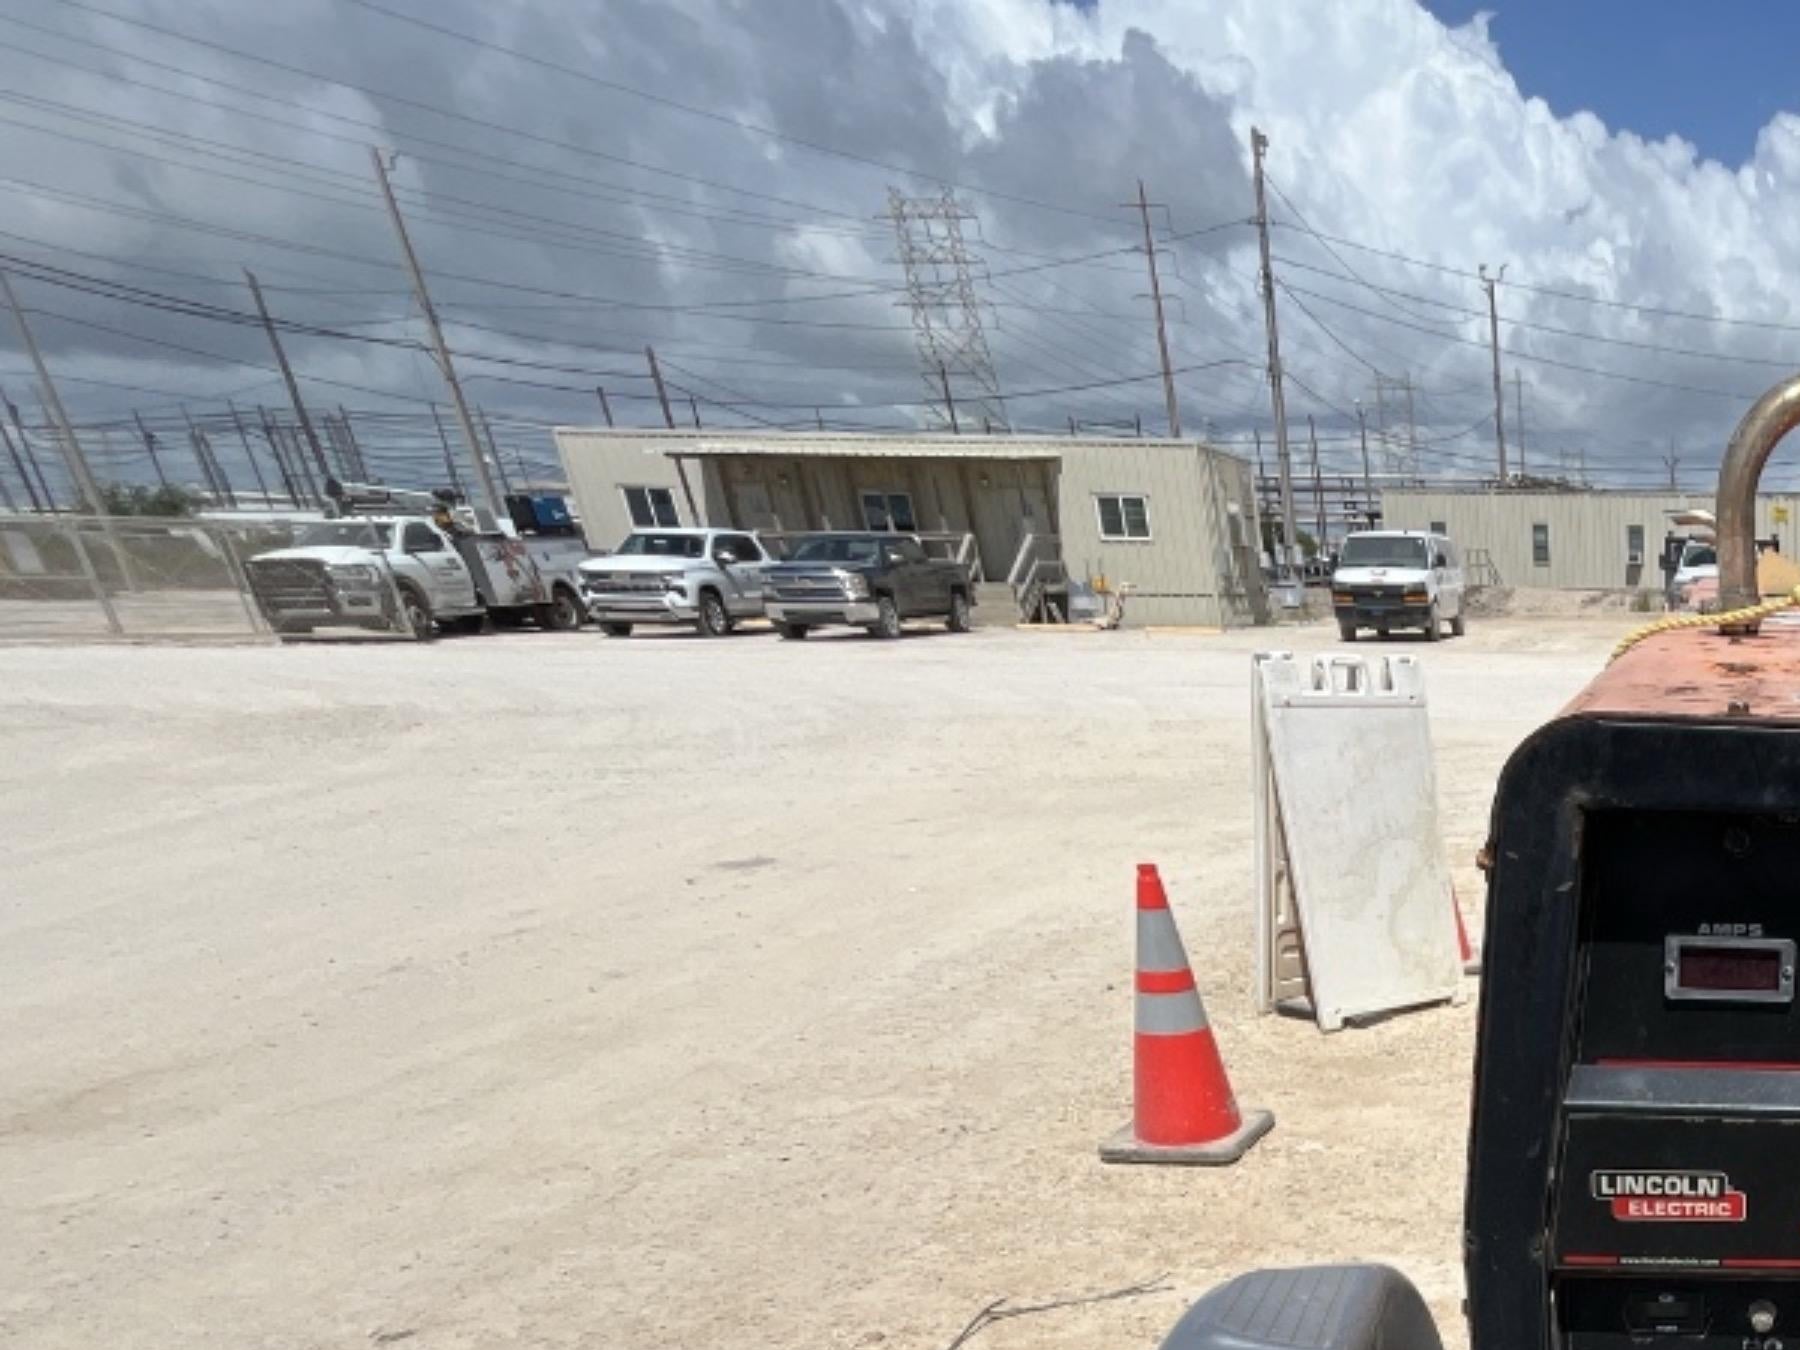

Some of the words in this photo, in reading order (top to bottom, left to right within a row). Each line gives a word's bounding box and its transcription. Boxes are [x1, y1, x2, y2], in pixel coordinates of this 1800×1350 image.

[1697, 922, 1763, 937] AMPS
[1600, 1175, 1720, 1198] LINCOLN
[1628, 1201, 1733, 1217] ELECTRIC
